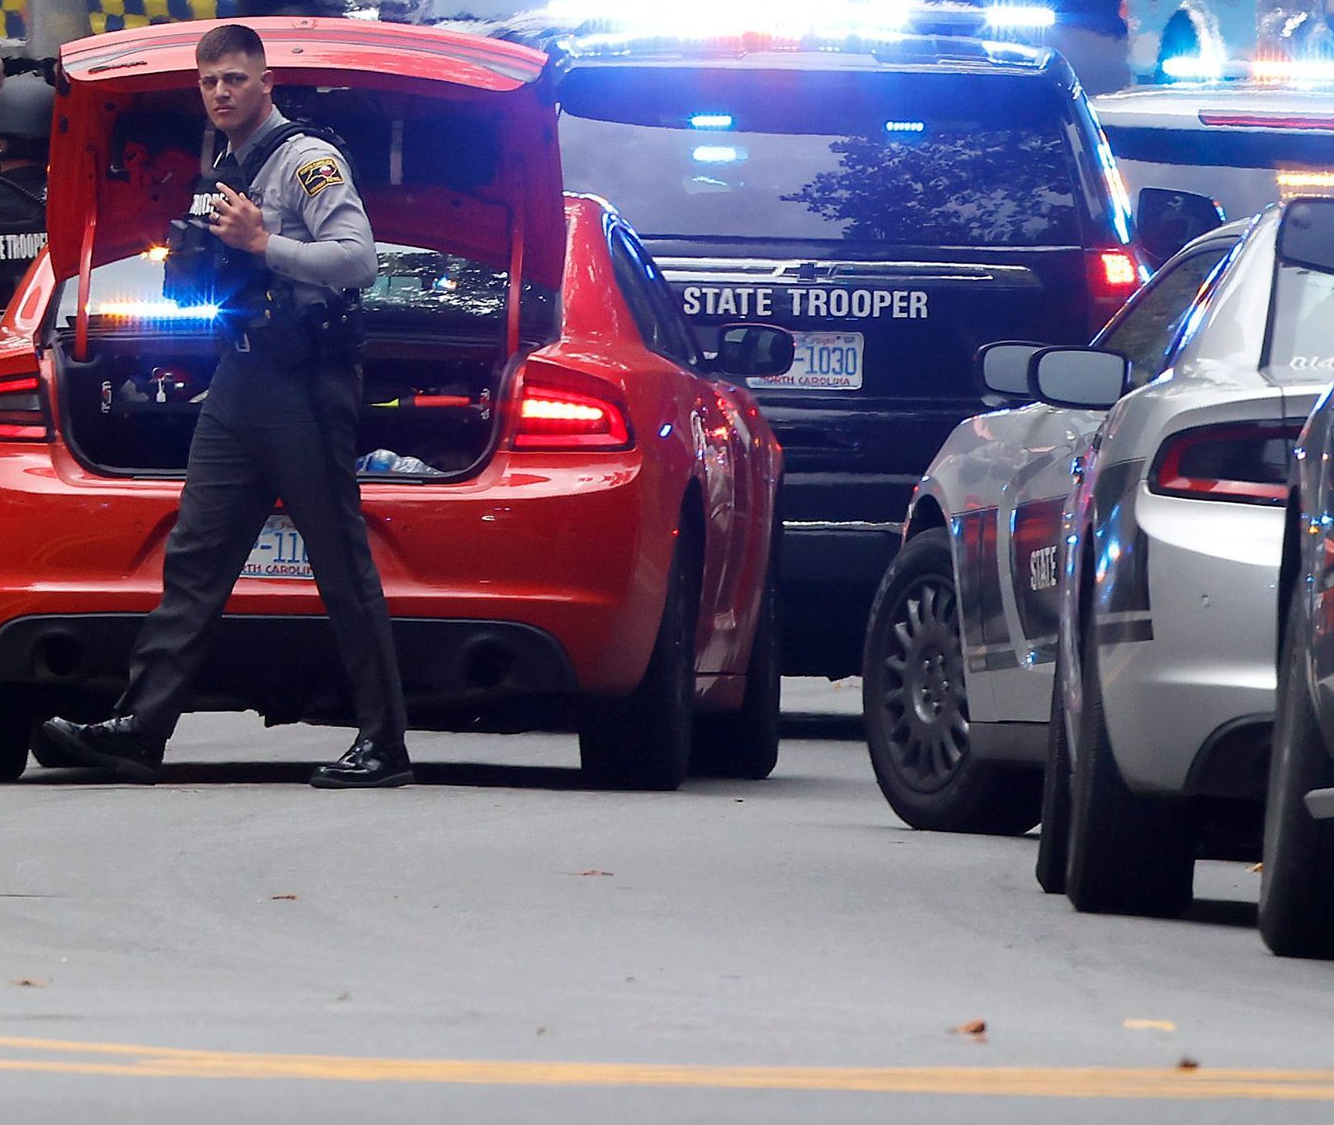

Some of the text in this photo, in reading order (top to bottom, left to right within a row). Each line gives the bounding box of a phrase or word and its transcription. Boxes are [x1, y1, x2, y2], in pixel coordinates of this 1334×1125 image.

[683, 287, 928, 318] STATE TROOPER
[794, 346, 857, 375] -1030
[798, 377, 850, 386] CAROLINA
[1030, 546, 1057, 590] STATE
